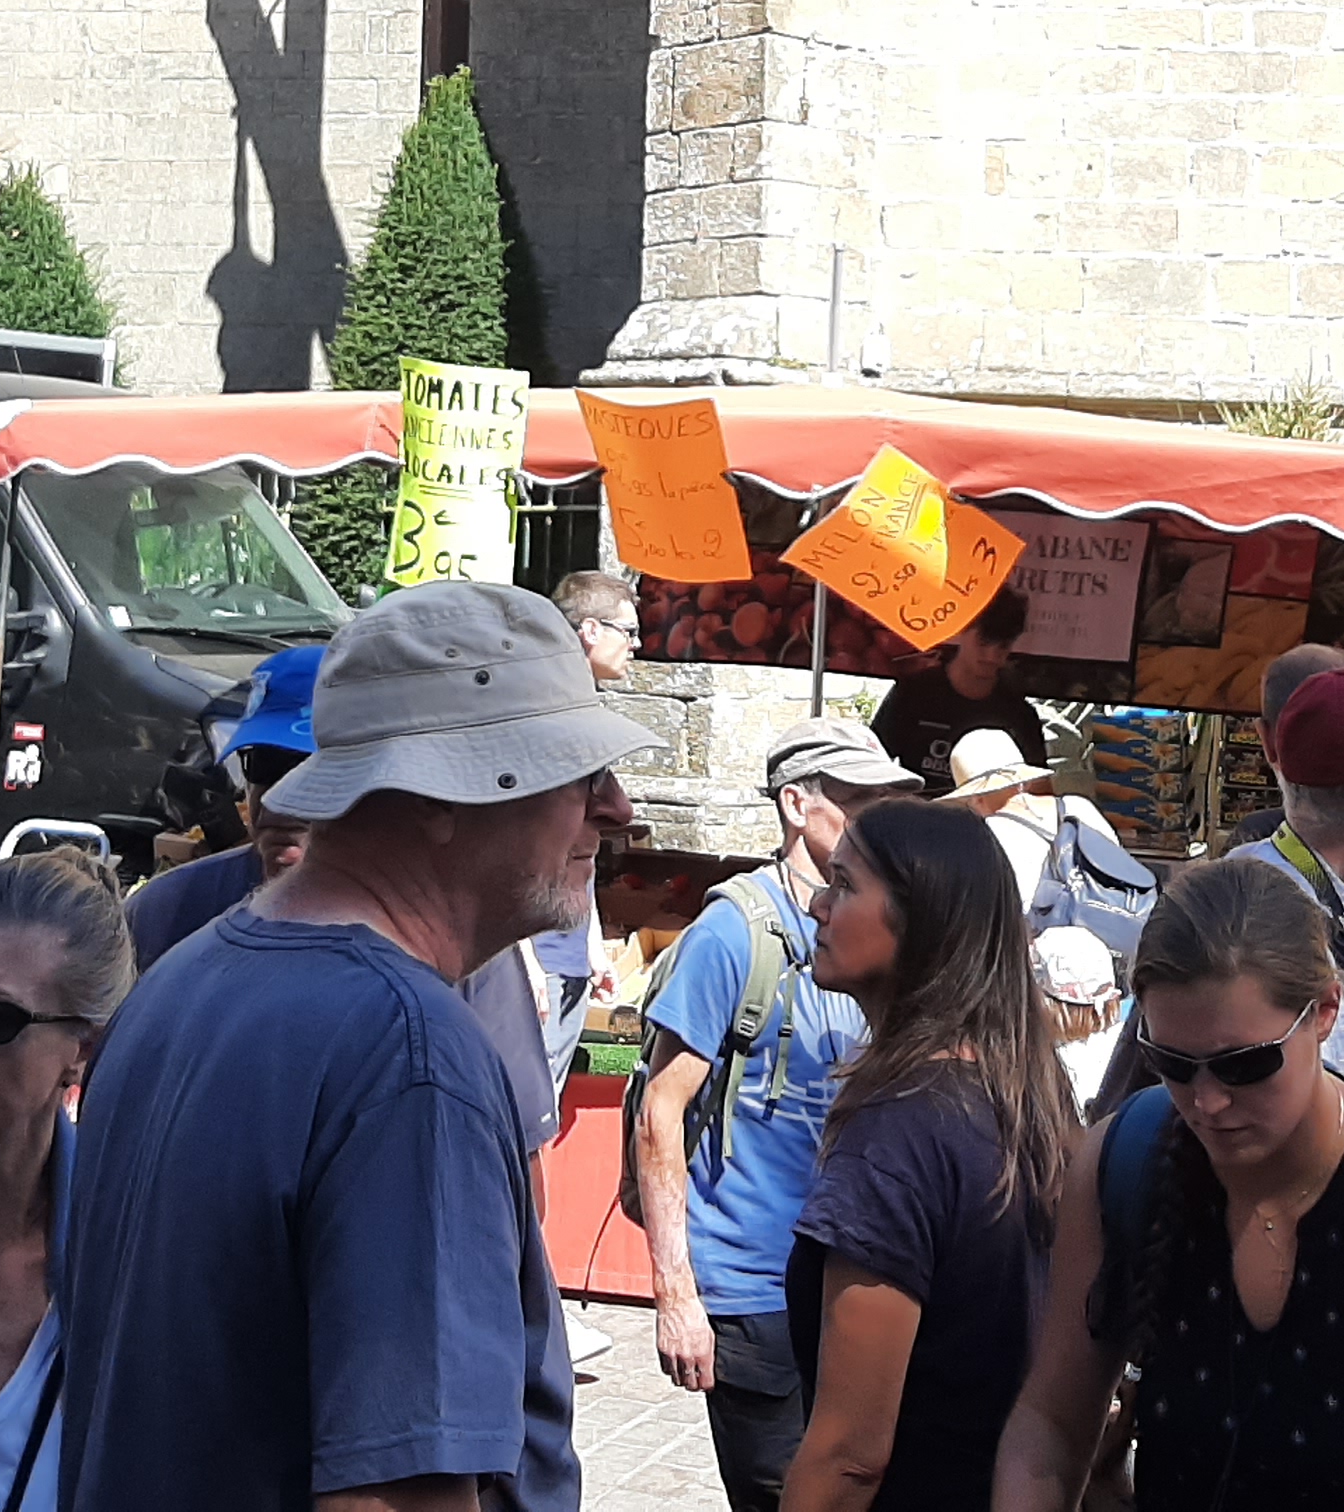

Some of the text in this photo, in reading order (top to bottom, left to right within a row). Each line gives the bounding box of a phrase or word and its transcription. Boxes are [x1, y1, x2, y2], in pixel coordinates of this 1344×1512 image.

[403, 368, 524, 420] TOMATES
[801, 486, 887, 571] MELON
[1016, 530, 1132, 562] ABANE
